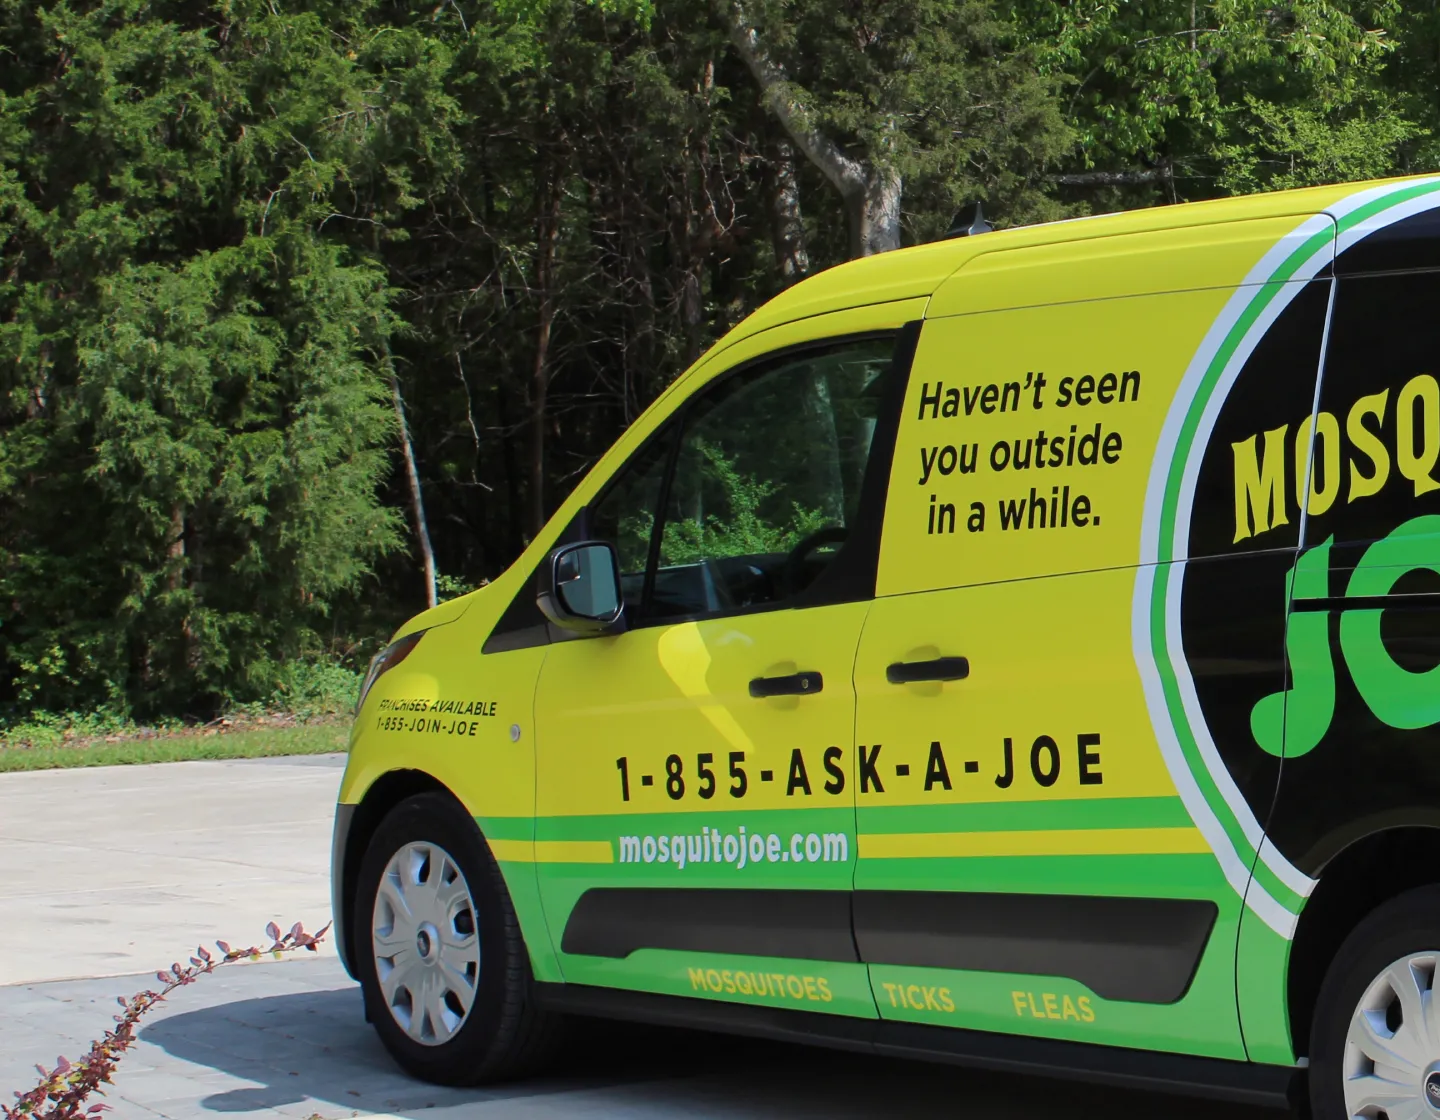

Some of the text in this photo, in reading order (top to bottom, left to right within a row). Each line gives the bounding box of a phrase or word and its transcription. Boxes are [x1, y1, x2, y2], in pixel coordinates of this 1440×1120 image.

[918, 369, 1141, 420] Haven't seen
[918, 423, 1123, 485] you outside
[927, 486, 1101, 534] in a while.
[377, 717, 479, 736] 1-855-JOIN-JOE
[429, 700, 497, 716] AVAILABLE
[616, 733, 1103, 801] 1-855-ASK-A-JOE
[619, 826, 848, 869] mosquitojoe.com
[687, 968, 1096, 1023] MOSQUITOES TICKS FLEAS
